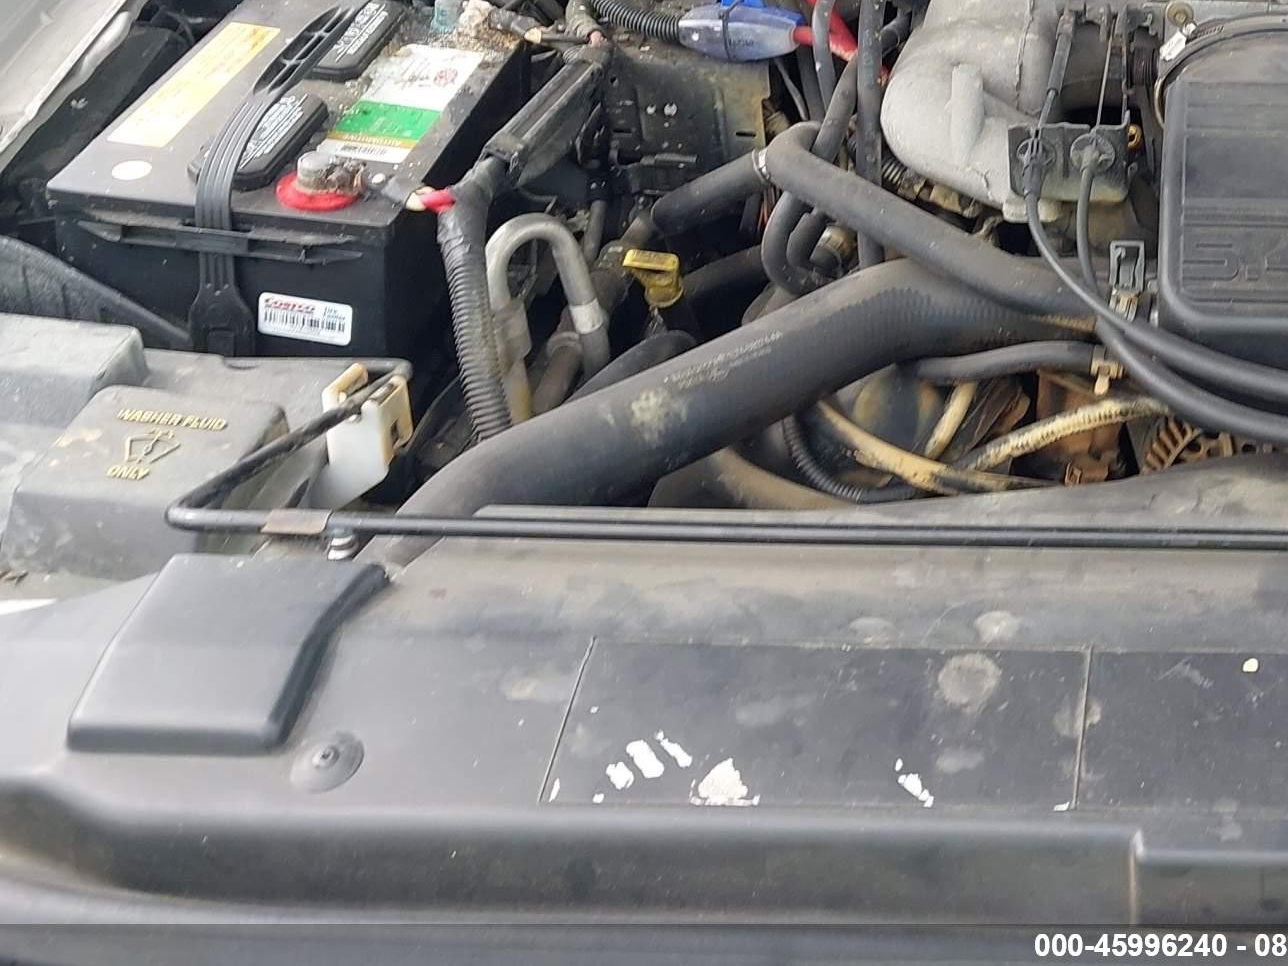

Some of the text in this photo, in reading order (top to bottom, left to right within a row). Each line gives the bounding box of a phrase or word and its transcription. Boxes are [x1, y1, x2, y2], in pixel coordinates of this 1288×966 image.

[117, 409, 228, 431] WASHER FLUID
[106, 465, 151, 481] ONLY
